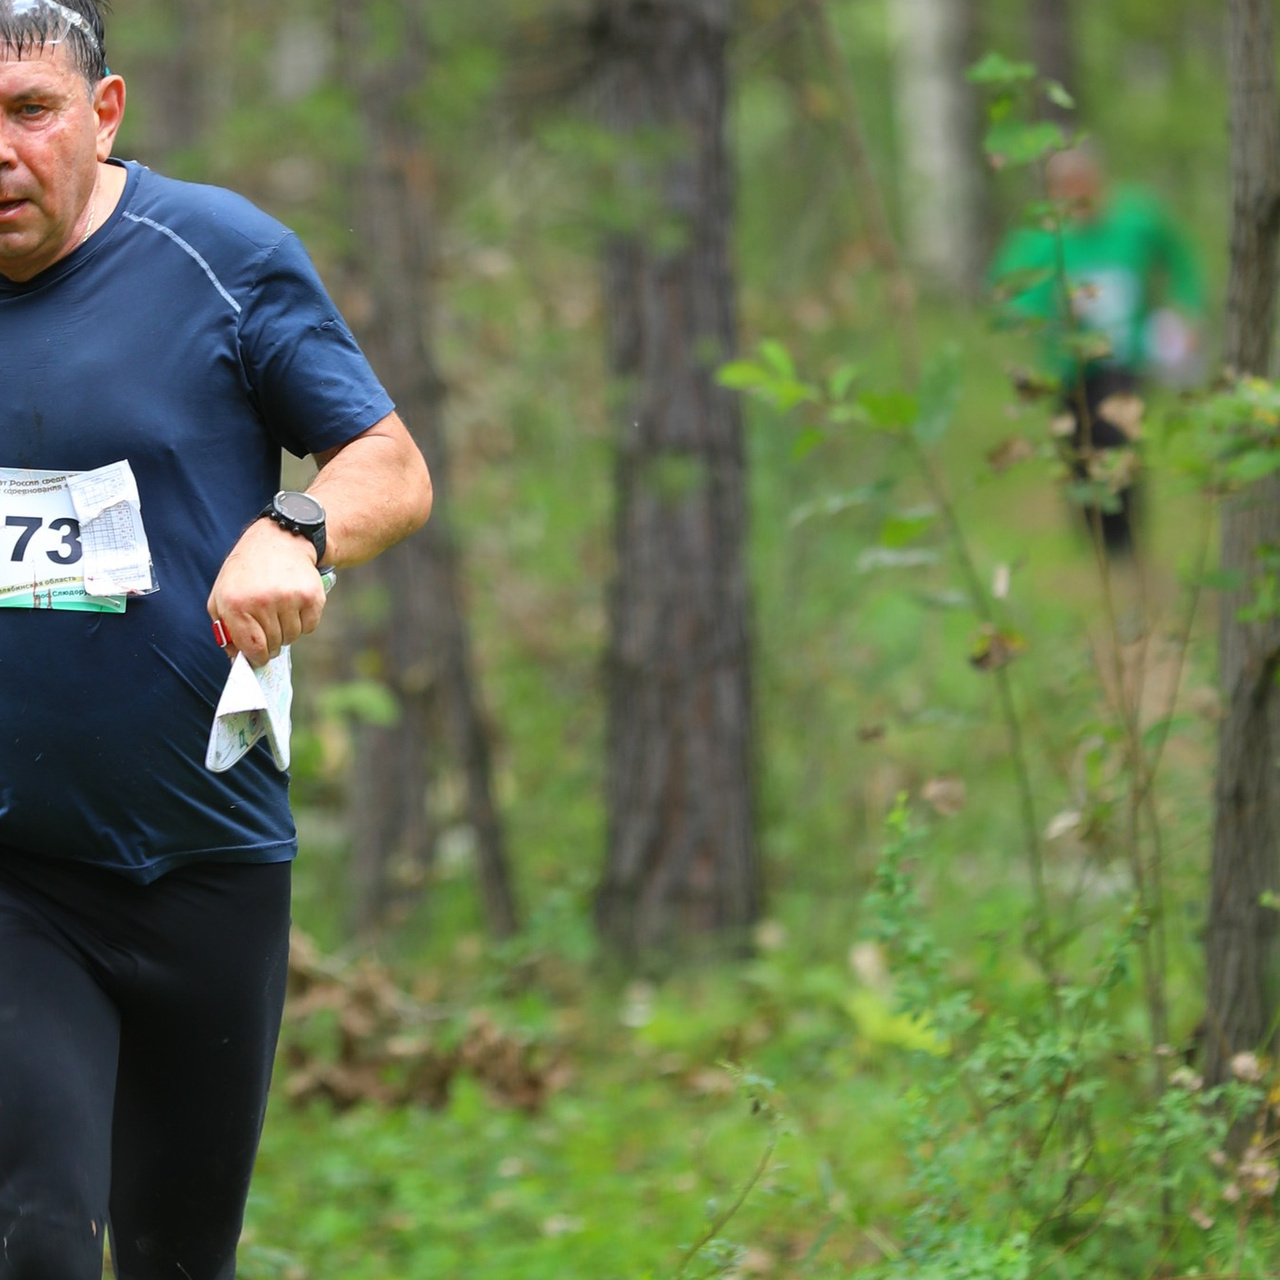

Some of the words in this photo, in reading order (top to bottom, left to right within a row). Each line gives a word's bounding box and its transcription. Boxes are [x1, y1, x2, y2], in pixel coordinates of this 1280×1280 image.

[9, 479, 40, 487] России
[3, 483, 63, 495] соревнования
[44, 576, 77, 586] область
